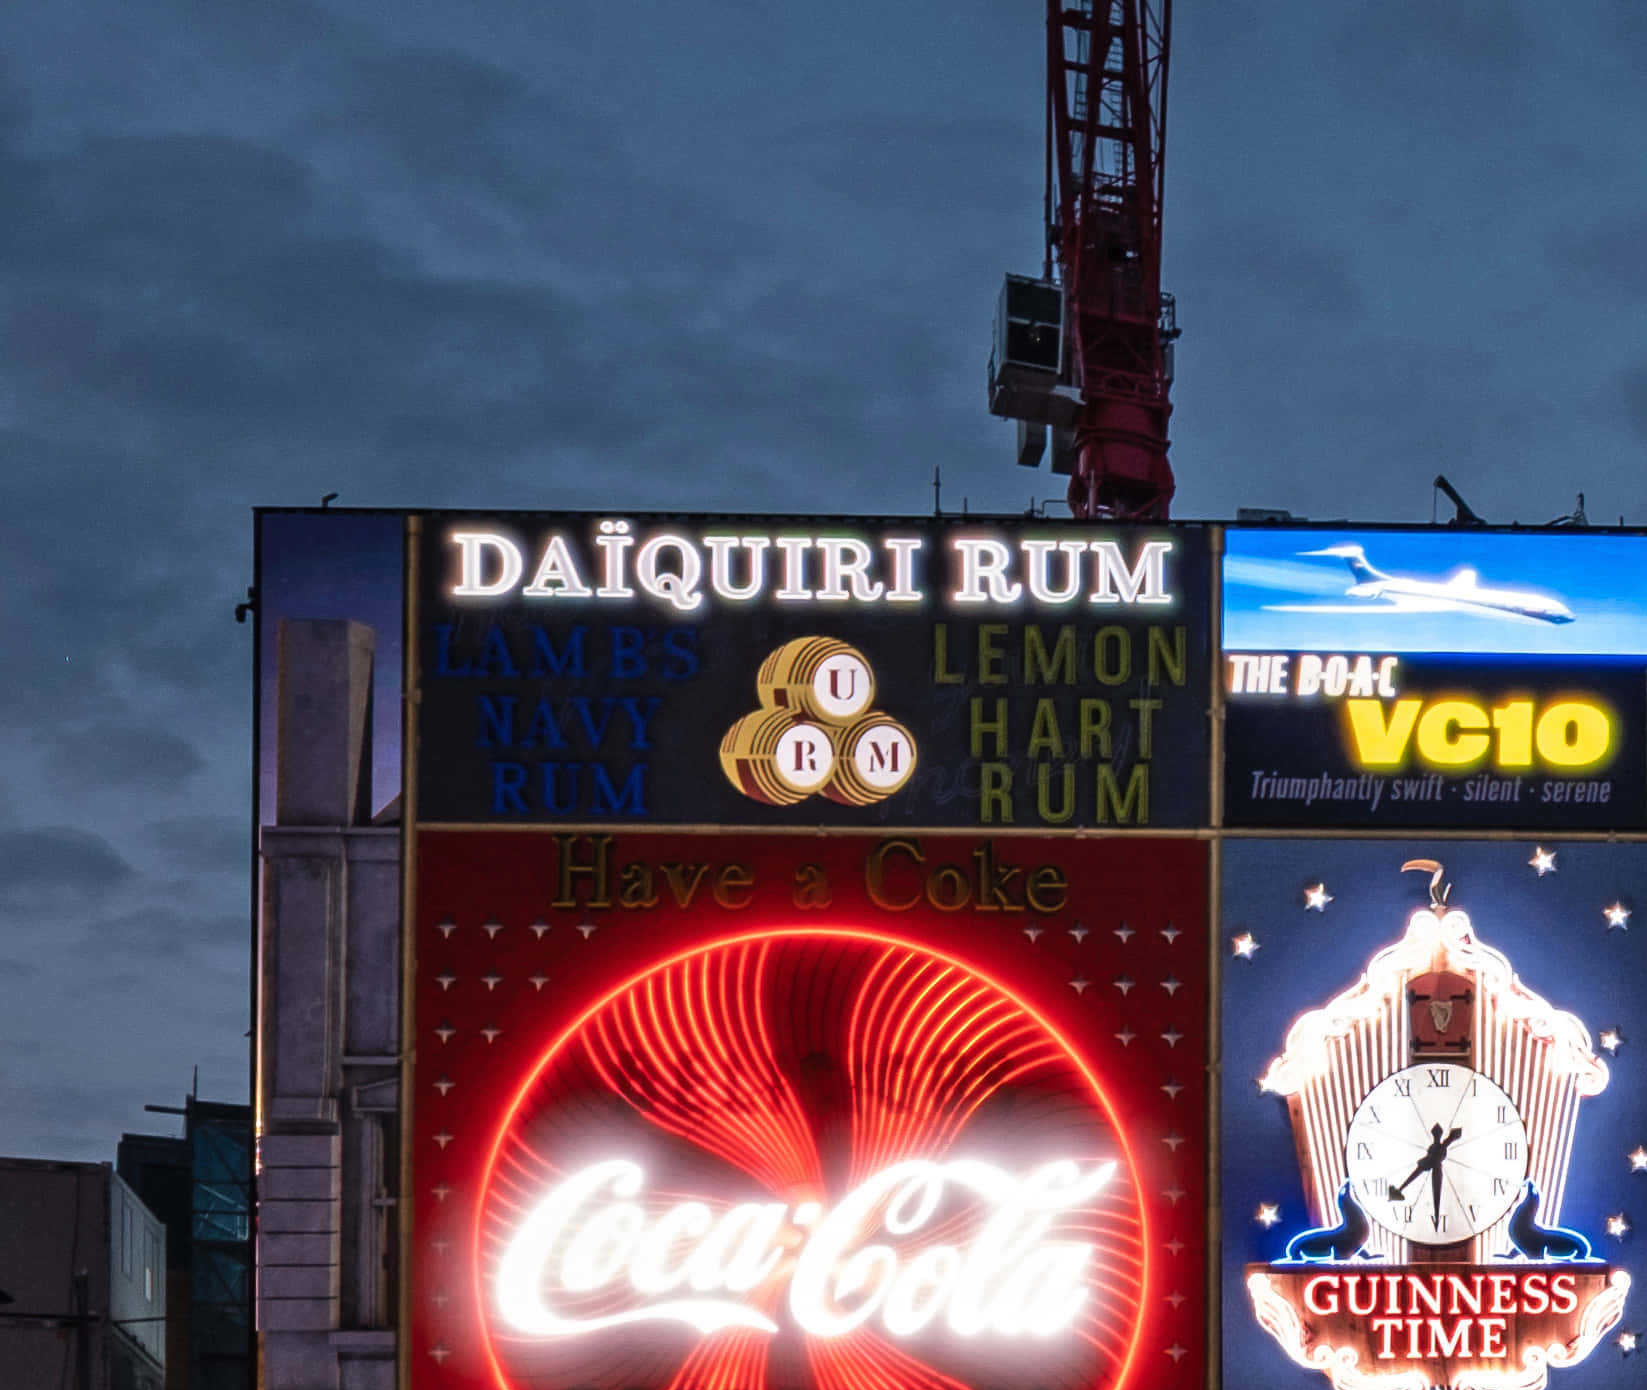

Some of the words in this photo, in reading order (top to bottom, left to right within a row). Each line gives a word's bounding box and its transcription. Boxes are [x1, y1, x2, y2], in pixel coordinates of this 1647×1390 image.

[452, 520, 924, 609] DAÏQUIRI
[954, 540, 1175, 604] RUM
[432, 624, 699, 680] LAMB'S
[934, 623, 1188, 686] LEMON
[1229, 655, 1288, 694] THE
[829, 668, 857, 700] U
[475, 695, 663, 749] NAVY
[969, 697, 1164, 759] HART
[1347, 699, 1610, 766] VC10
[793, 740, 817, 771] R
[869, 741, 900, 772] M
[488, 761, 649, 817] RUM
[980, 761, 1150, 825] RUM
[1250, 770, 1384, 812] Triumphantly
[1391, 773, 1445, 802] swift
[1463, 774, 1521, 802] silent
[1541, 779, 1611, 803] serene
[551, 834, 755, 910] Have
[791, 863, 833, 910] a
[864, 837, 1069, 912] Coke
[1303, 1274, 1579, 1317] GUINNESS
[1371, 1317, 1508, 1360] TIME
